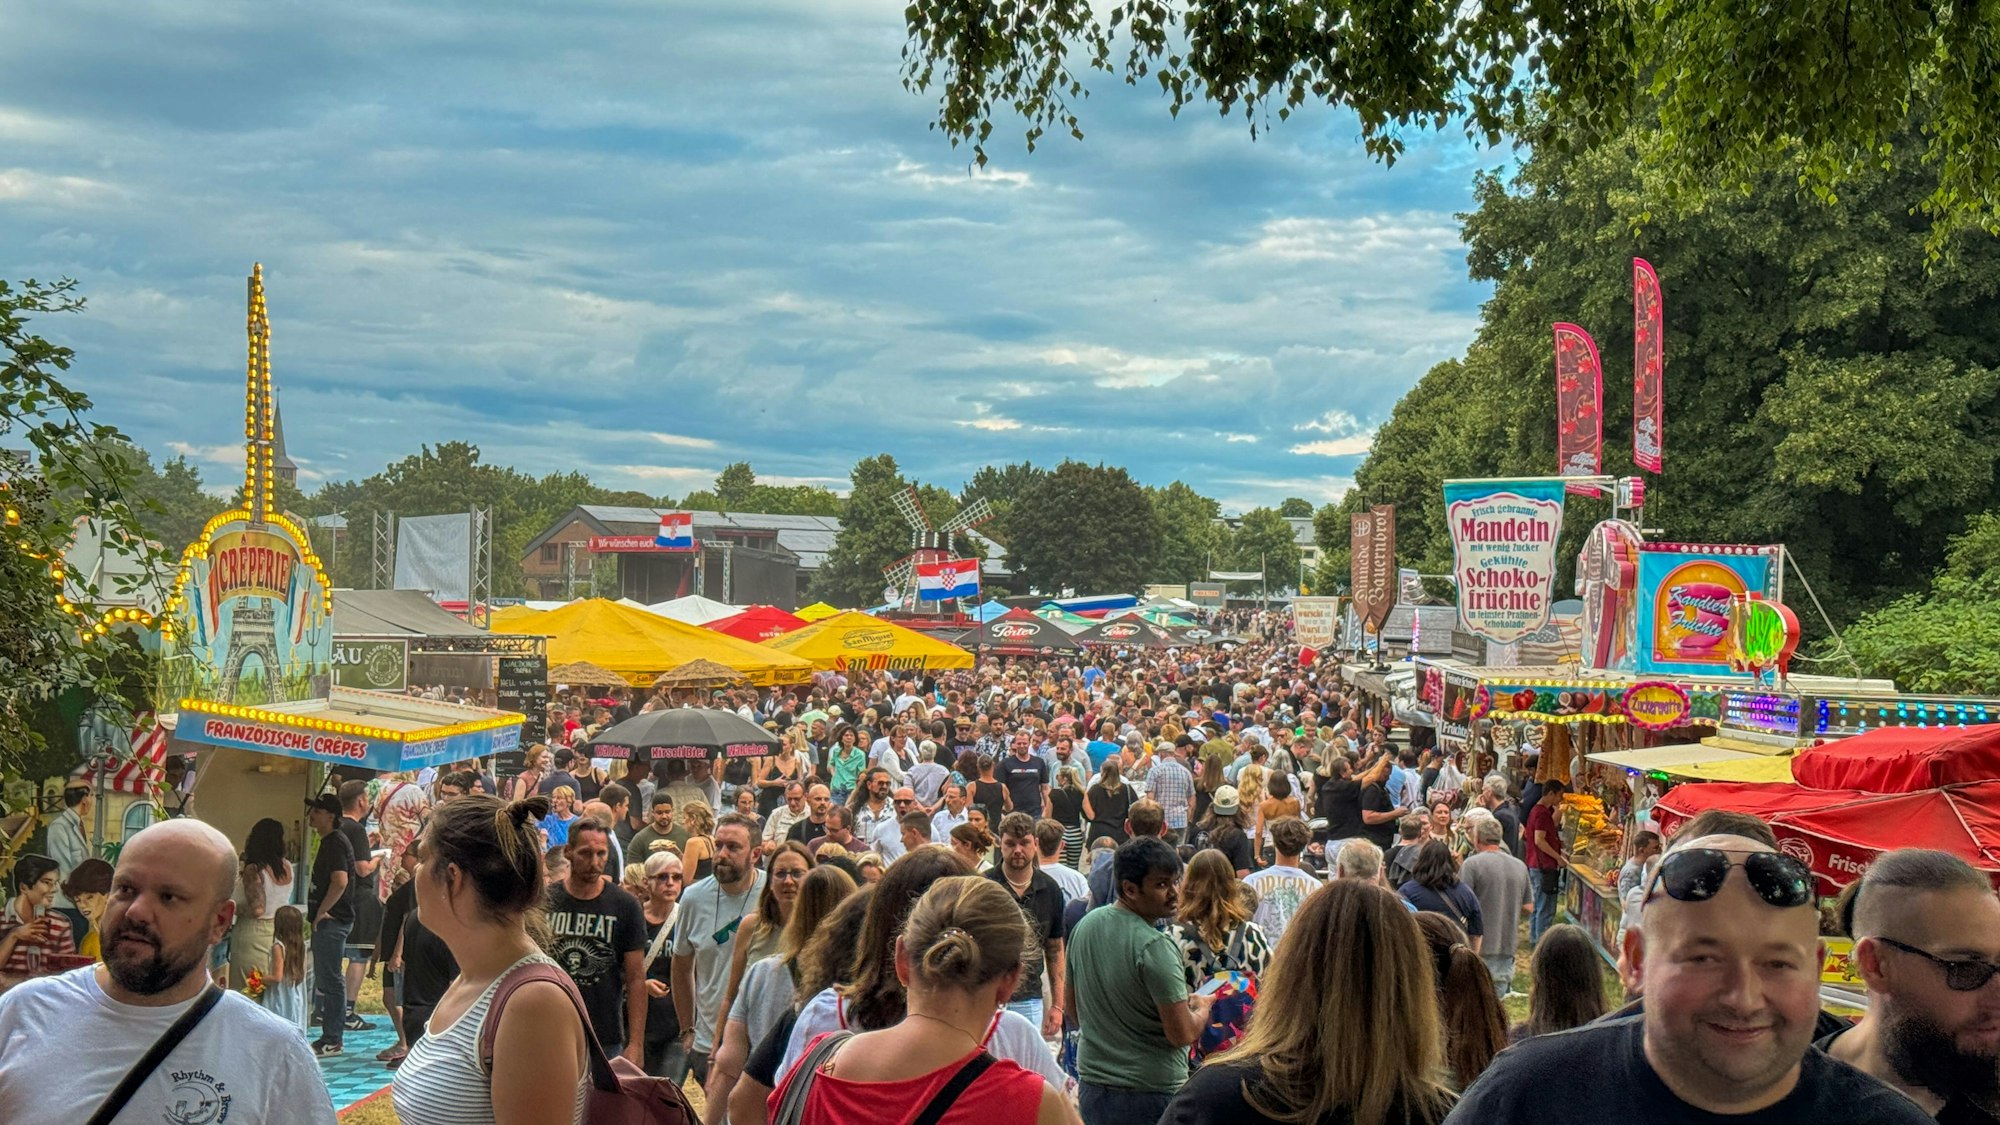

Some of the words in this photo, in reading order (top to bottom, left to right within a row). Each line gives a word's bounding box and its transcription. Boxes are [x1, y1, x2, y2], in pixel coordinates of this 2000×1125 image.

[1472, 506, 1495, 517] Frisch
[1497, 505, 1538, 517] gebrannte
[1461, 518, 1549, 542] Mandeln
[1368, 511, 1387, 605] Bauernbrot
[1470, 544, 1483, 552] mit
[1486, 544, 1510, 552] wenig
[1513, 544, 1539, 552] Zucker
[219, 534, 289, 593] CRÊPERIE
[1480, 555, 1528, 568] Gekühlte
[1466, 568, 1546, 588] Schoko-
[1469, 589, 1541, 610] früchte
[1469, 611, 1475, 619] in
[1478, 611, 1504, 619] feinster
[1484, 620, 1526, 628] Schokolade
[1671, 610, 1724, 637] Früchte
[835, 654, 868, 670] San
[1632, 693, 1681, 716] Zuckerwatte
[206, 719, 312, 750] FRANZÖSISCHE
[314, 736, 367, 759] CRÊPES
[546, 912, 618, 943] VOLBEAT
[171, 1069, 215, 1083] Rhythm
